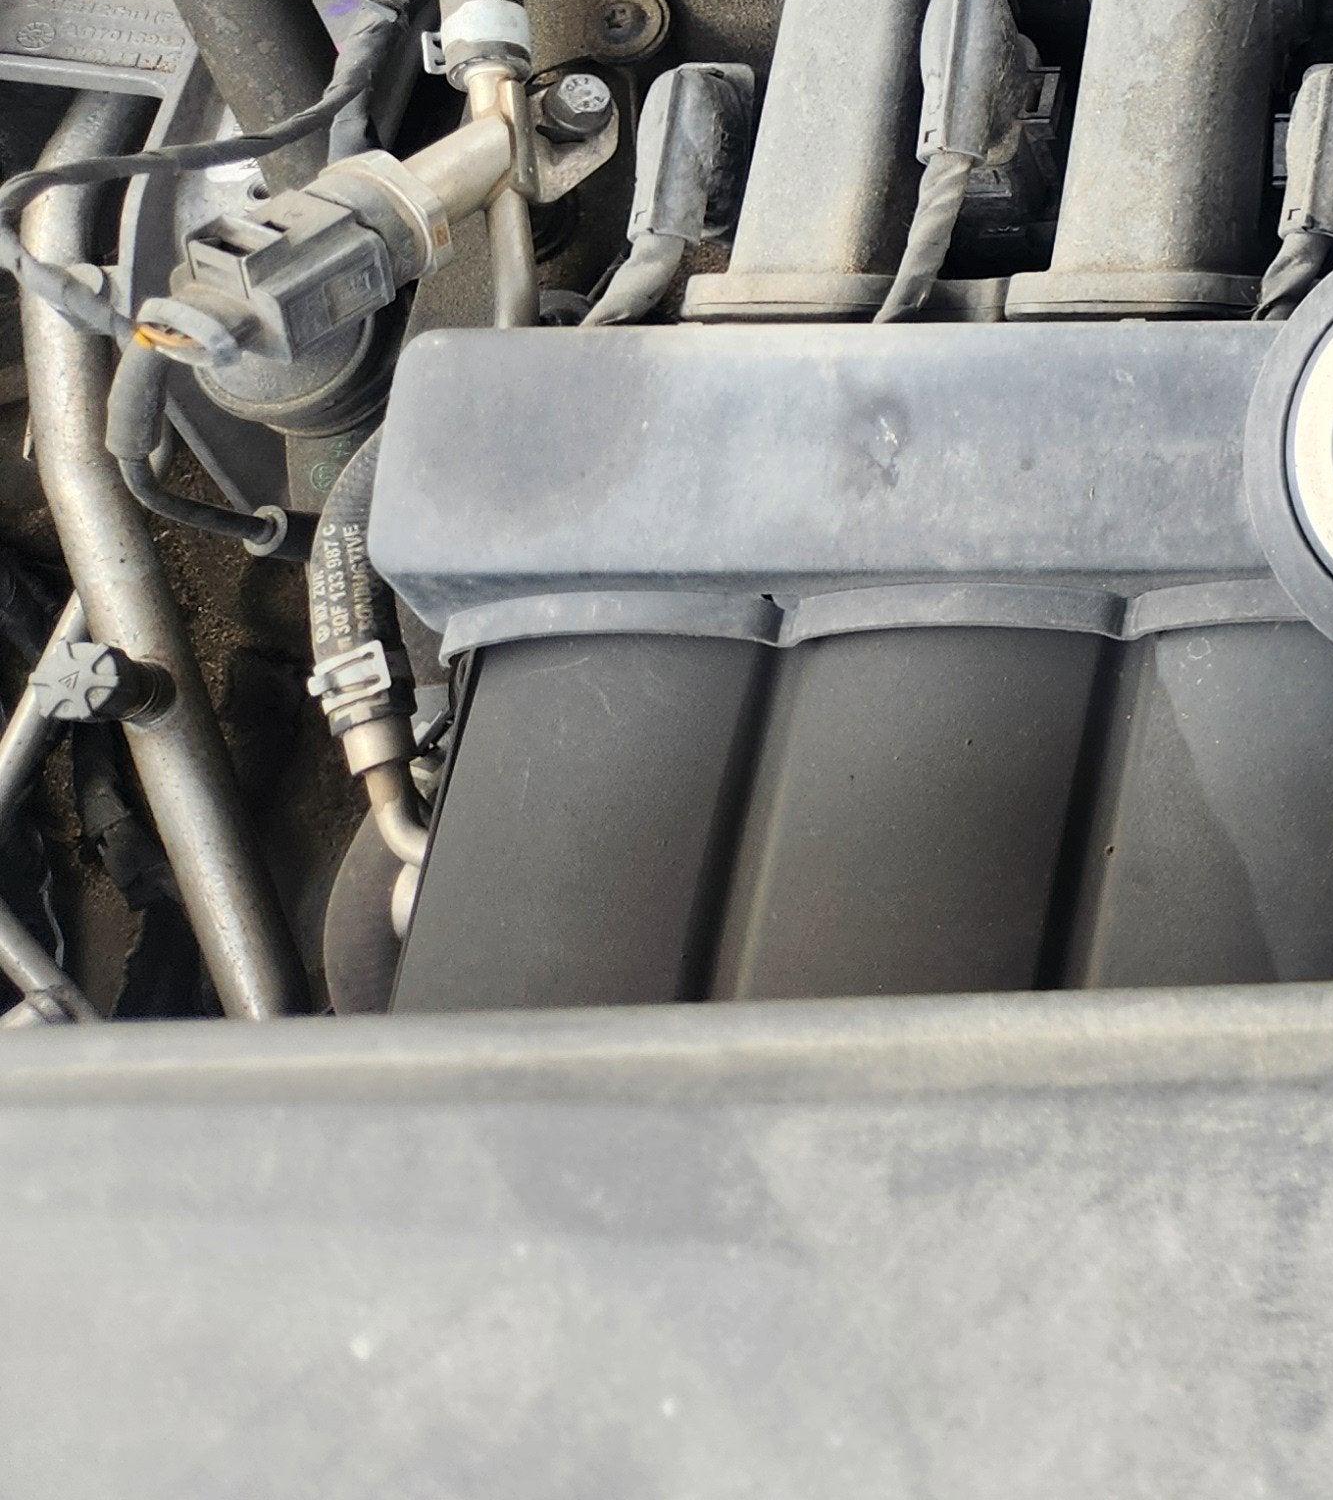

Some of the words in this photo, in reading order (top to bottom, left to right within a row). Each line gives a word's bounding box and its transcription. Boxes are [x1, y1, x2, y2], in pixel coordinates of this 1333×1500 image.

[322, 523, 336, 536] C
[324, 540, 343, 569] 987
[328, 570, 346, 602] 133
